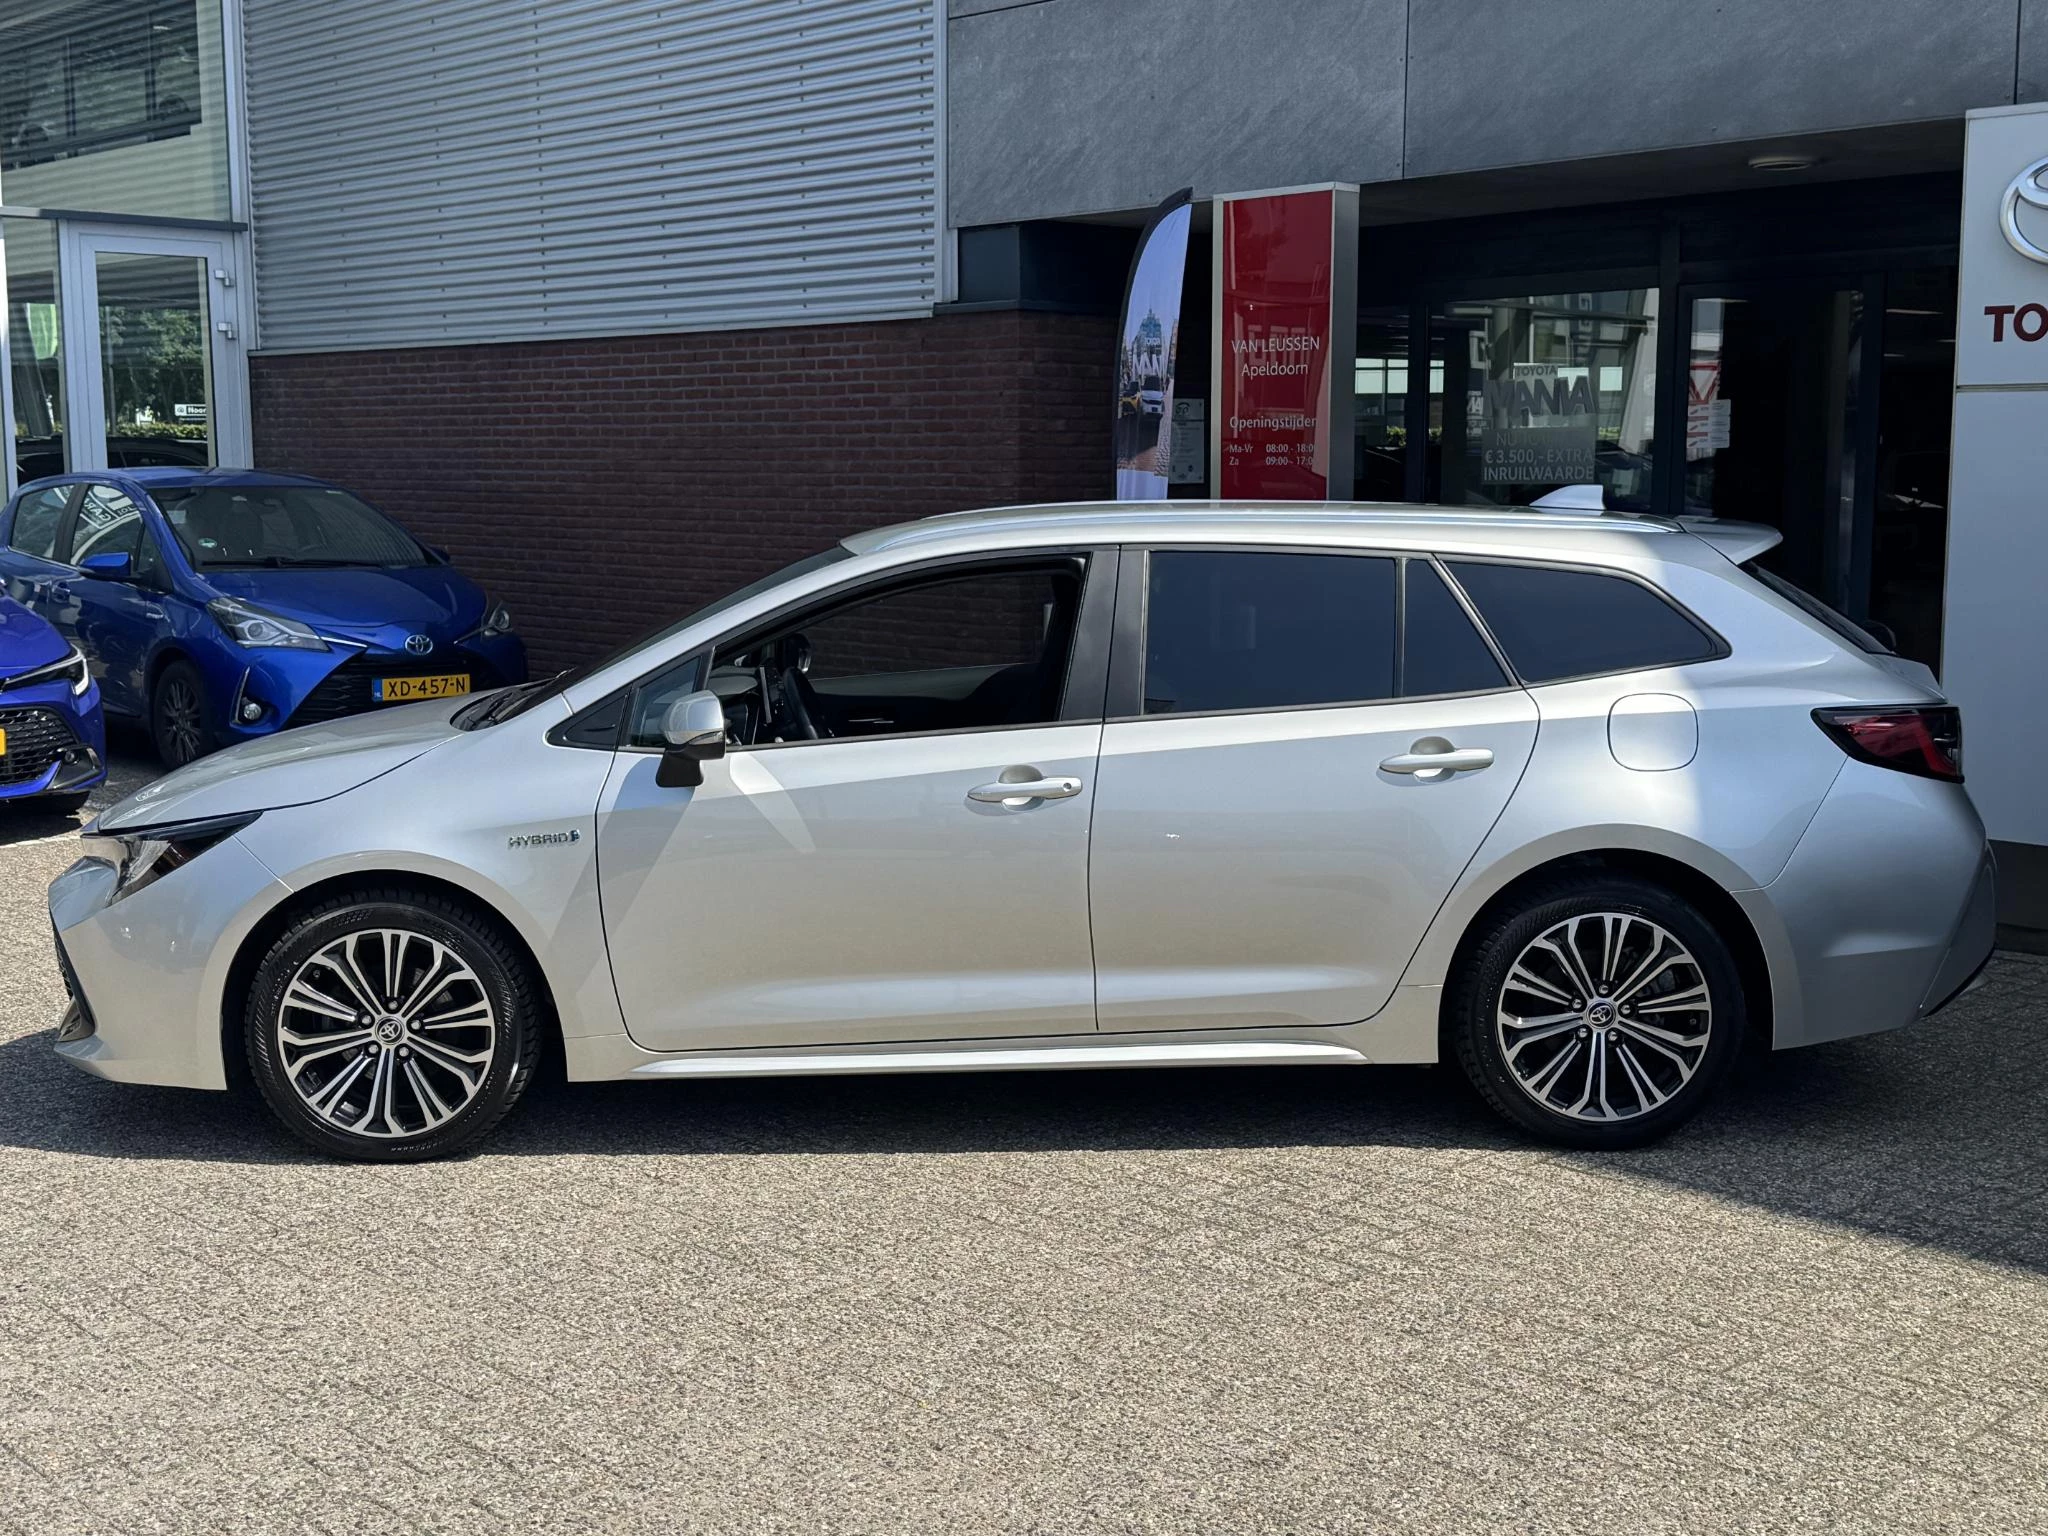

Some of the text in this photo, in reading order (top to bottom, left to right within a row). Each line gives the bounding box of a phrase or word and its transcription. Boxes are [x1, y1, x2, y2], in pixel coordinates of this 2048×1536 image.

[1984, 302, 2048, 343] TO
[1231, 335, 1320, 354] VAN LEUSSEN
[1241, 362, 1309, 380] Apeldoorn
[1515, 365, 1558, 377] TOYOTA
[1483, 375, 1597, 418] MANIA
[1229, 415, 1319, 432] Openingstijden
[1229, 442, 1253, 454] Ma-Vr
[1265, 443, 1289, 454] 08:00
[1297, 442, 1315, 453] 18:0
[1547, 448, 1594, 463] EXTRA
[1265, 456, 1289, 467] 09:00
[1296, 456, 1313, 467] 17:0
[1483, 465, 1595, 481] INRUILWAARDE
[388, 676, 465, 697] XD-457-N
[508, 832, 568, 848] HYBRID
